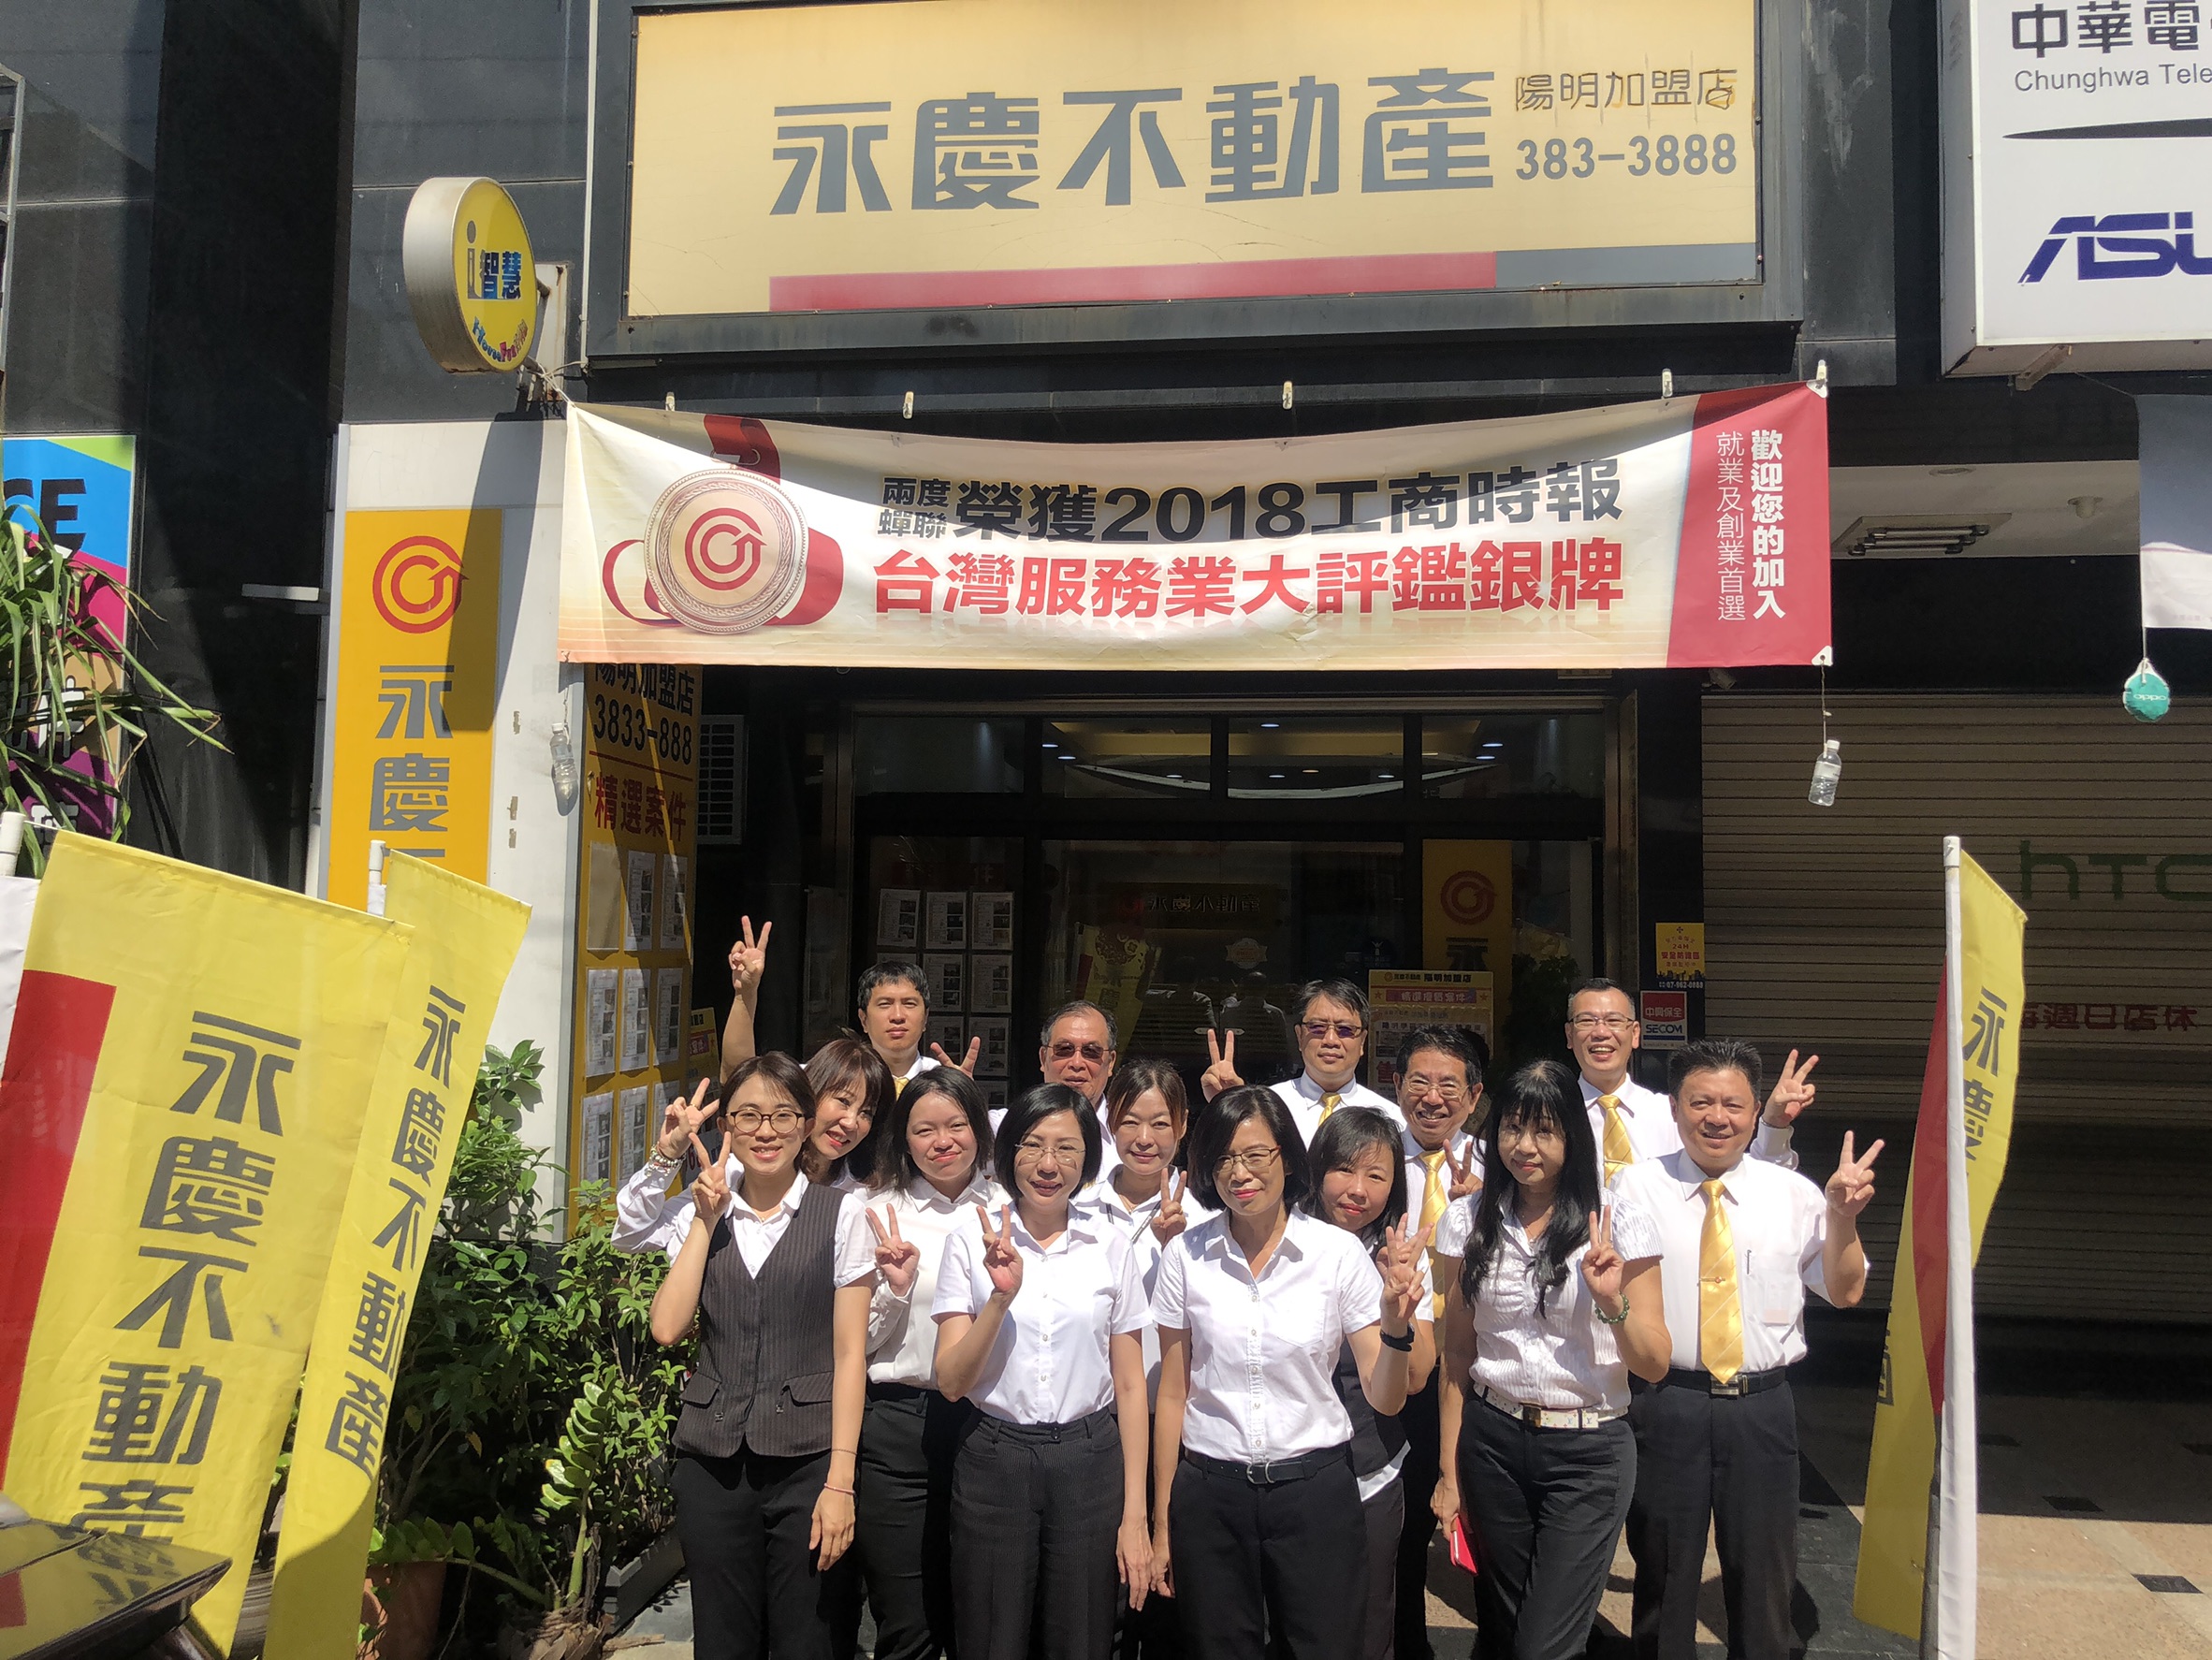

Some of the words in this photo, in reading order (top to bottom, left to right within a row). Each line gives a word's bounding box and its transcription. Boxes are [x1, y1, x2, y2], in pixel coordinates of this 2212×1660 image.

[2012, 0, 2212, 58] 中華電
[1515, 68, 1738, 112] 陽明加盟店
[2015, 66, 2148, 94] Chunghwa
[2159, 63, 2212, 85] Tele
[769, 67, 1494, 215] 永慶不動產
[1515, 133, 1737, 181] 383-3888
[878, 508, 948, 540] 蟬聯
[882, 476, 951, 509] 兩度
[953, 457, 1622, 544] 榮獲2018工商時報
[1716, 431, 1746, 621] 就業及創業首選
[1751, 430, 1785, 619] 歡迎您的加入
[872, 536, 1624, 619] 台灣服務業大評鑑銀牌
[369, 664, 455, 858] 永慶
[593, 693, 692, 765] 3833-888
[594, 772, 688, 842] 精選案件
[1645, 1024, 1683, 1034] SECOM
[326, 984, 467, 1481] 永慶不動產
[70, 1011, 302, 1544] 永慶不動產
